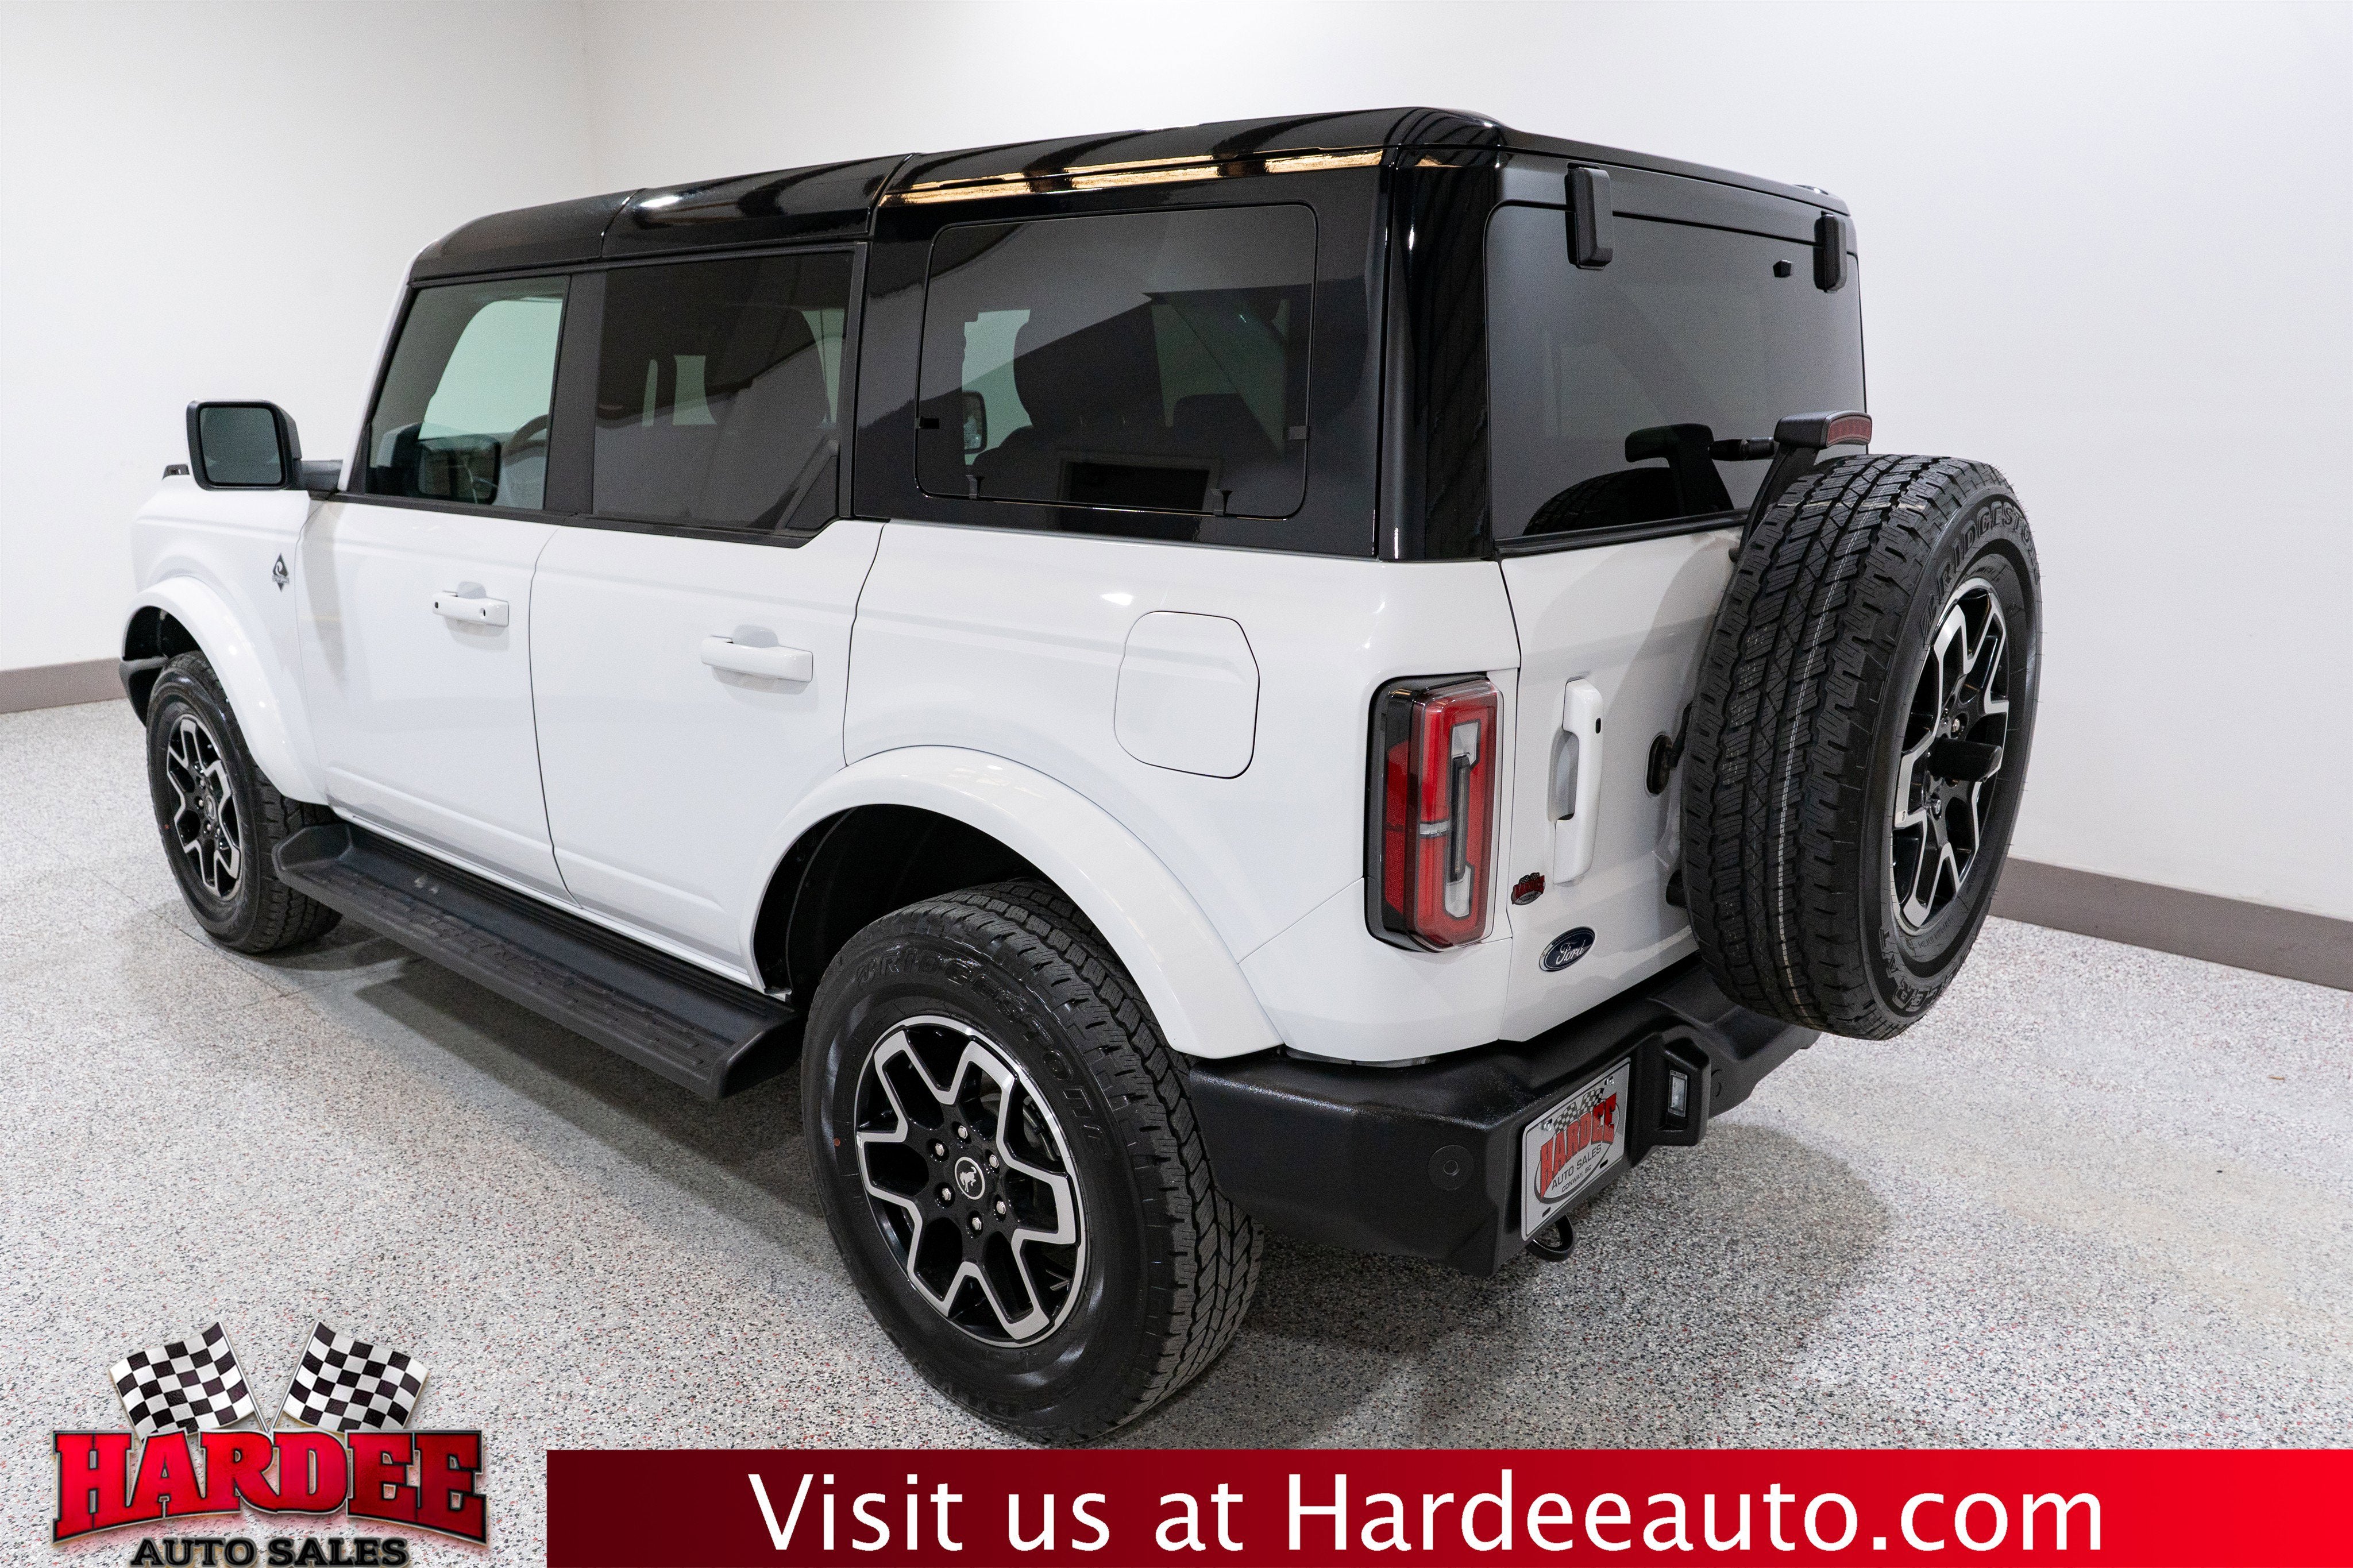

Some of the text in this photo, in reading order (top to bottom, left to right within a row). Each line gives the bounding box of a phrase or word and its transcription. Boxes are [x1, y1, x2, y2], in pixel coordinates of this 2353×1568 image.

[1556, 939, 1587, 965] Ford
[1540, 1092, 1617, 1199] HARDEE
[1552, 1144, 1602, 1191] AUTO SALES
[1585, 1164, 1592, 1174] SC
